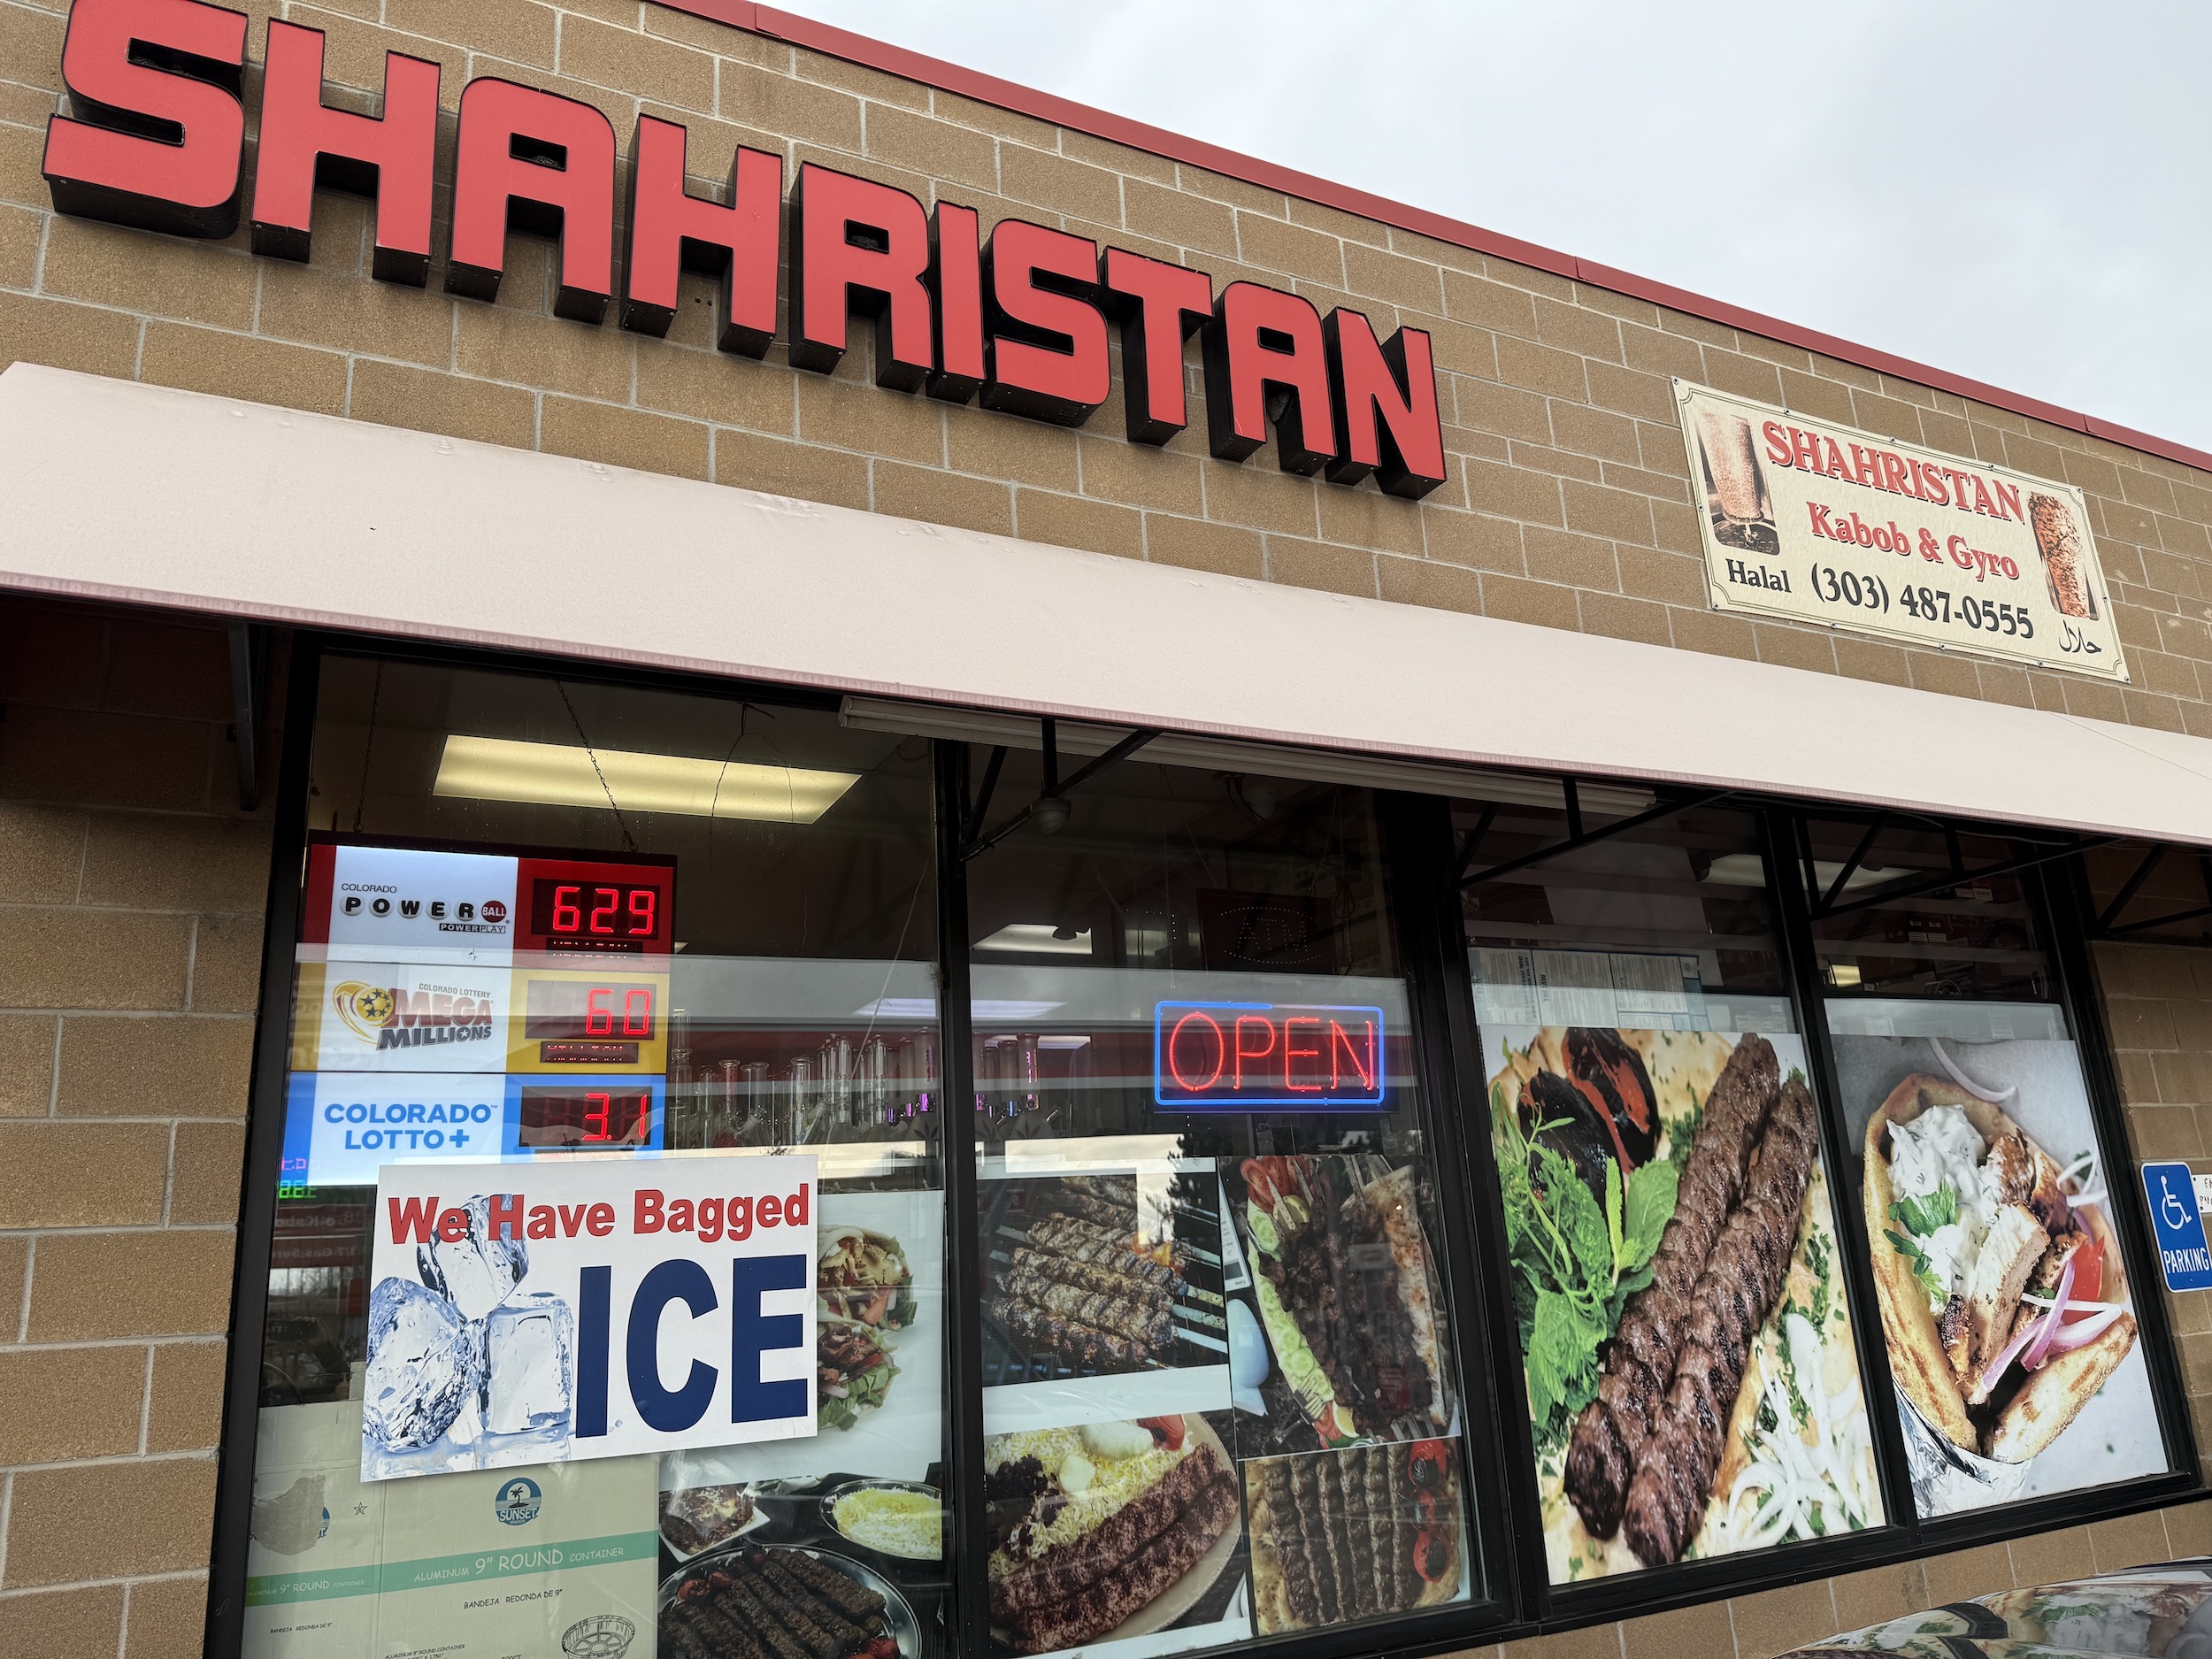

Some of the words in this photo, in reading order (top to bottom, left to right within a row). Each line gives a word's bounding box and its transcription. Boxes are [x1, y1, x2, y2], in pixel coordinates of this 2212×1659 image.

[41, 0, 1448, 495] SHAHRISTAN
[1762, 419, 2025, 526] SHAHRISTAN
[1806, 501, 1911, 557] Kabob
[1917, 526, 1944, 565] &
[1947, 534, 2020, 582] Gyro
[1726, 558, 1792, 594] Halal
[1811, 562, 1890, 615] (303)
[1900, 584, 2035, 640] 487-0555
[2058, 619, 2102, 656] حلال
[341, 882, 397, 894] COLORADO
[552, 885, 656, 936] 629
[381, 987, 493, 1029] MEGA
[419, 982, 458, 995] COLORADO
[459, 988, 491, 999] LOTTERY
[585, 987, 652, 1036] 60
[376, 1025, 493, 1051] MILLIONS
[1168, 1011, 1375, 1093] OPEN
[324, 1102, 492, 1124] COLORADO
[388, 1195, 469, 1245] We
[488, 1194, 616, 1240] Have
[633, 1182, 810, 1242] Bagged
[2162, 1247, 2210, 1274] PARKING
[574, 1254, 809, 1440] ICE
[499, 1507, 539, 1522] SUNSET
[413, 1566, 470, 1582] ALUMINUM
[497, 1548, 564, 1571] ROUND
[569, 1547, 625, 1563] CONTAINER
[292, 1579, 330, 1593] ROUND
[464, 1597, 500, 1609] BANDEJA
[505, 1592, 542, 1604] REDONDA
[543, 1589, 555, 1599] DE
[436, 1643, 465, 1653] CONTAINER
